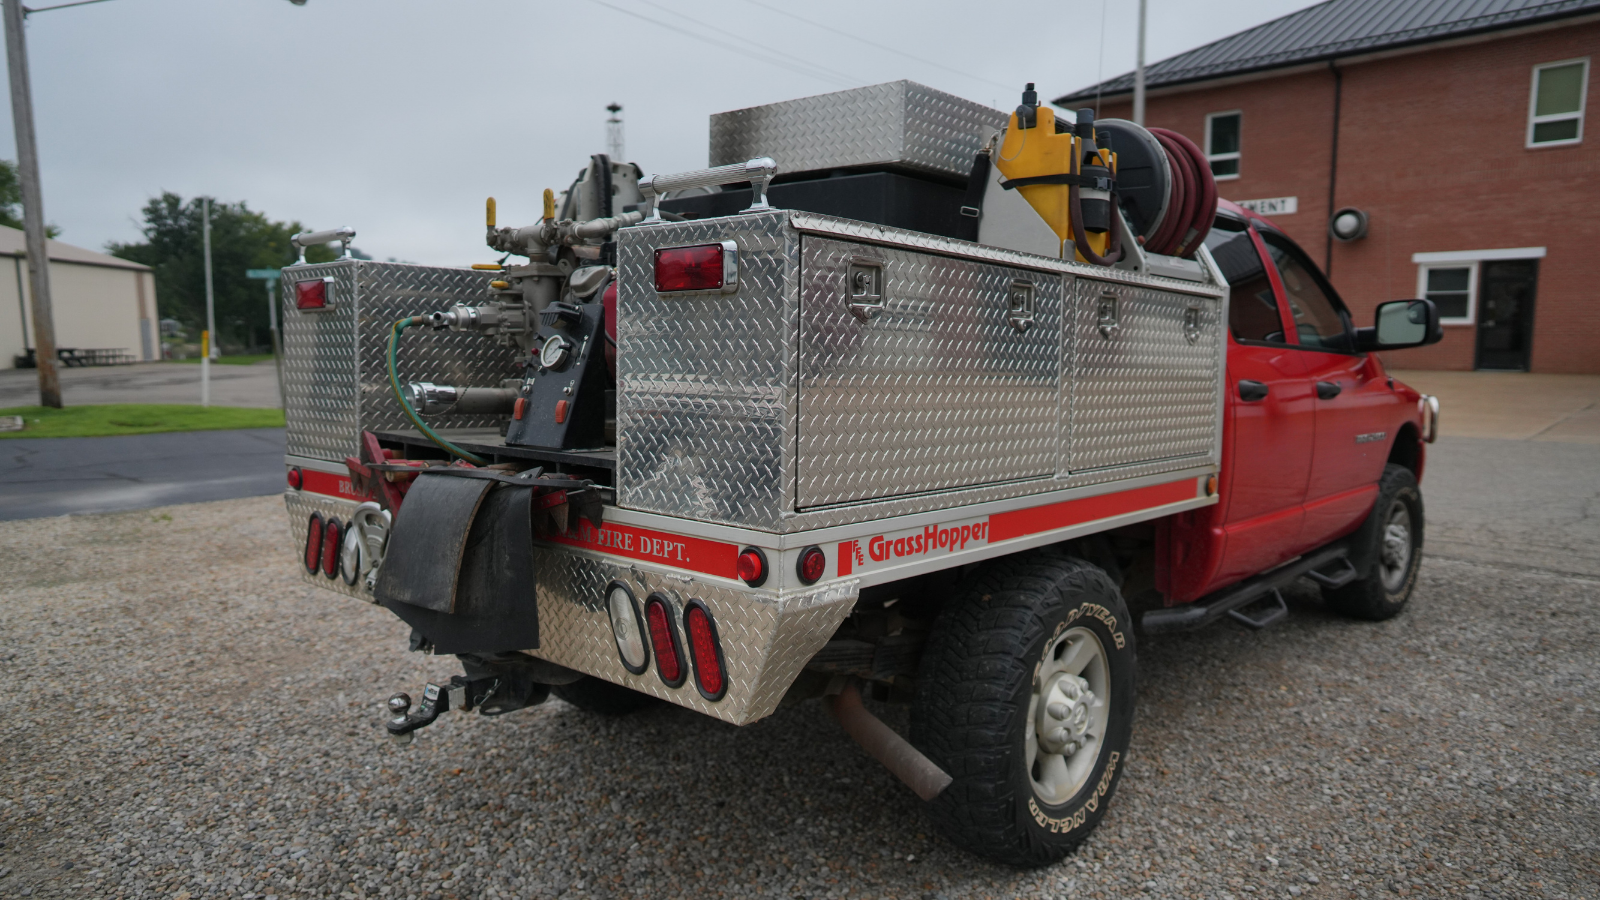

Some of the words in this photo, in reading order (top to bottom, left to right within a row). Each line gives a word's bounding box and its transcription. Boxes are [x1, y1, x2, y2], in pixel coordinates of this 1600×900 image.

[1240, 200, 1287, 213] MENT
[597, 528, 634, 551] FIRE
[640, 536, 690, 562] DEPT.
[868, 521, 989, 562] GrassHopper
[1028, 751, 1120, 833] WRANGLER
